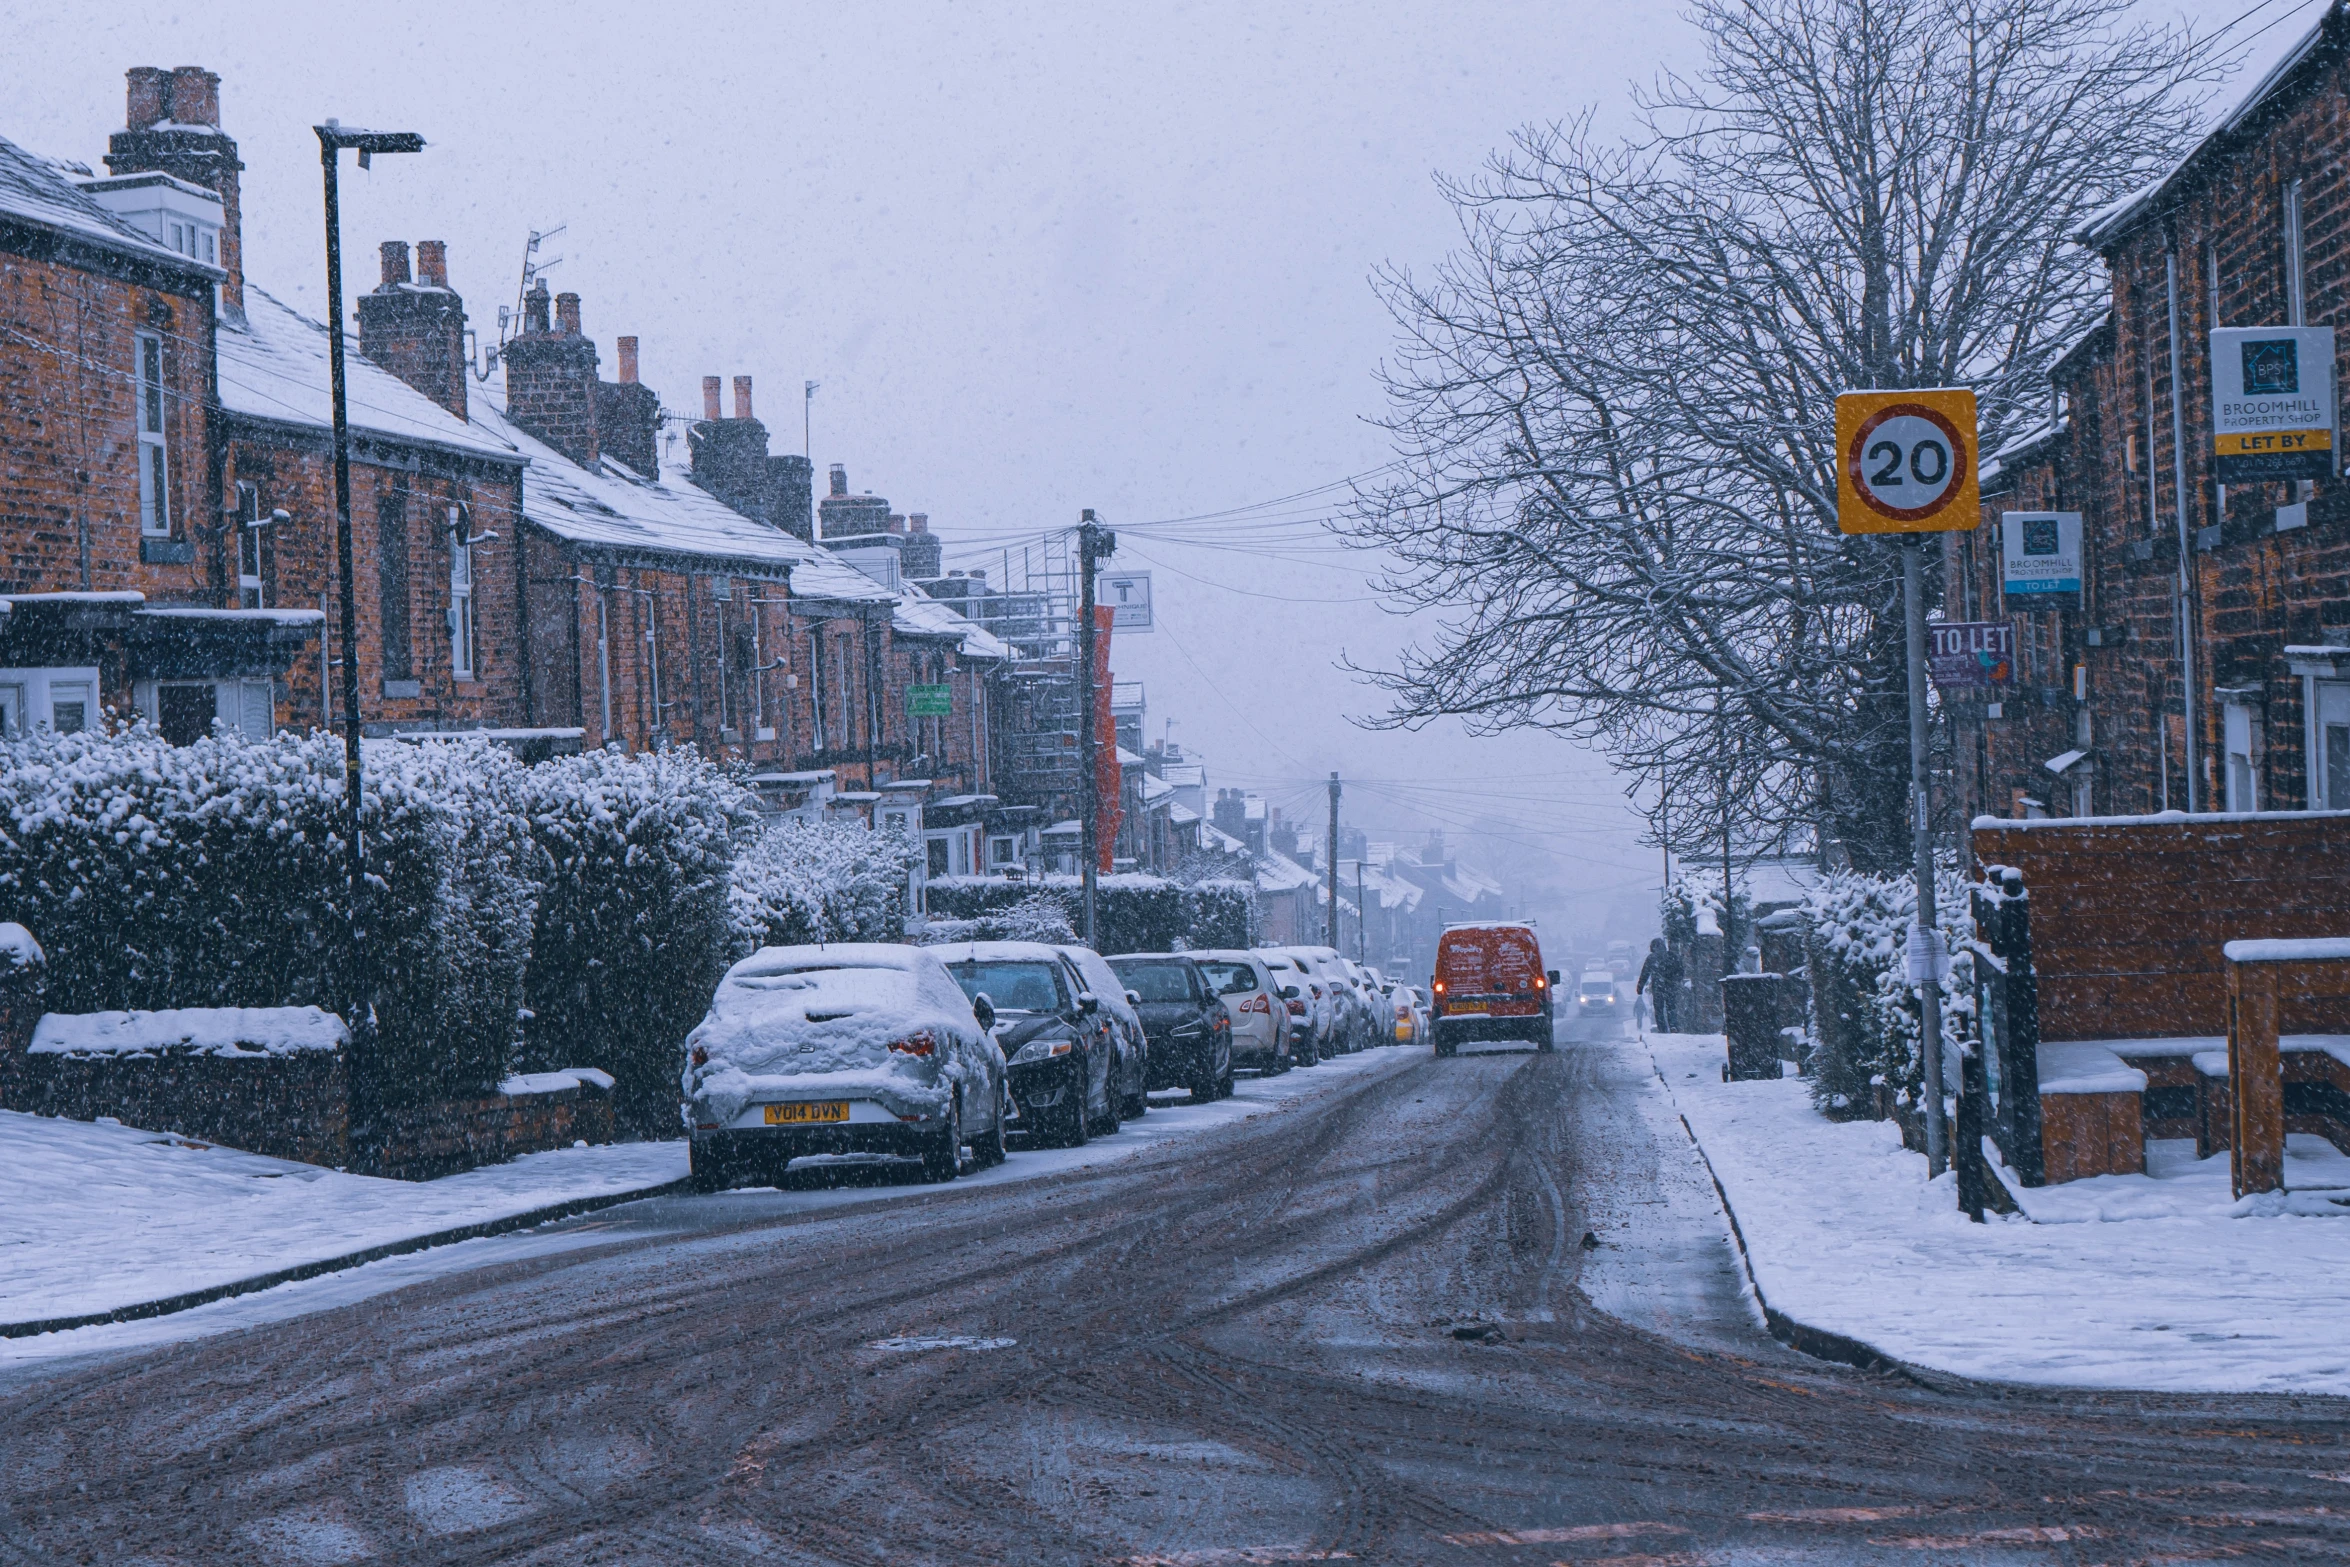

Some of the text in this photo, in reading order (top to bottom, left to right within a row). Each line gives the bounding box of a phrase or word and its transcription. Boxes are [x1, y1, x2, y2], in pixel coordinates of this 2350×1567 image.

[2258, 363, 2281, 376] BPS
[2223, 400, 2320, 416] BROOMHILL
[2224, 413, 2321, 427] PROPERTY SHOP
[2241, 434, 2306, 450] LET BY
[1868, 439, 1948, 486] 20
[2010, 559, 2072, 569] BROOMHILL
[2010, 567, 2073, 576] PROPERTY SHOP
[2025, 581, 2060, 590] TO LET
[1932, 627, 2009, 655] TO LET
